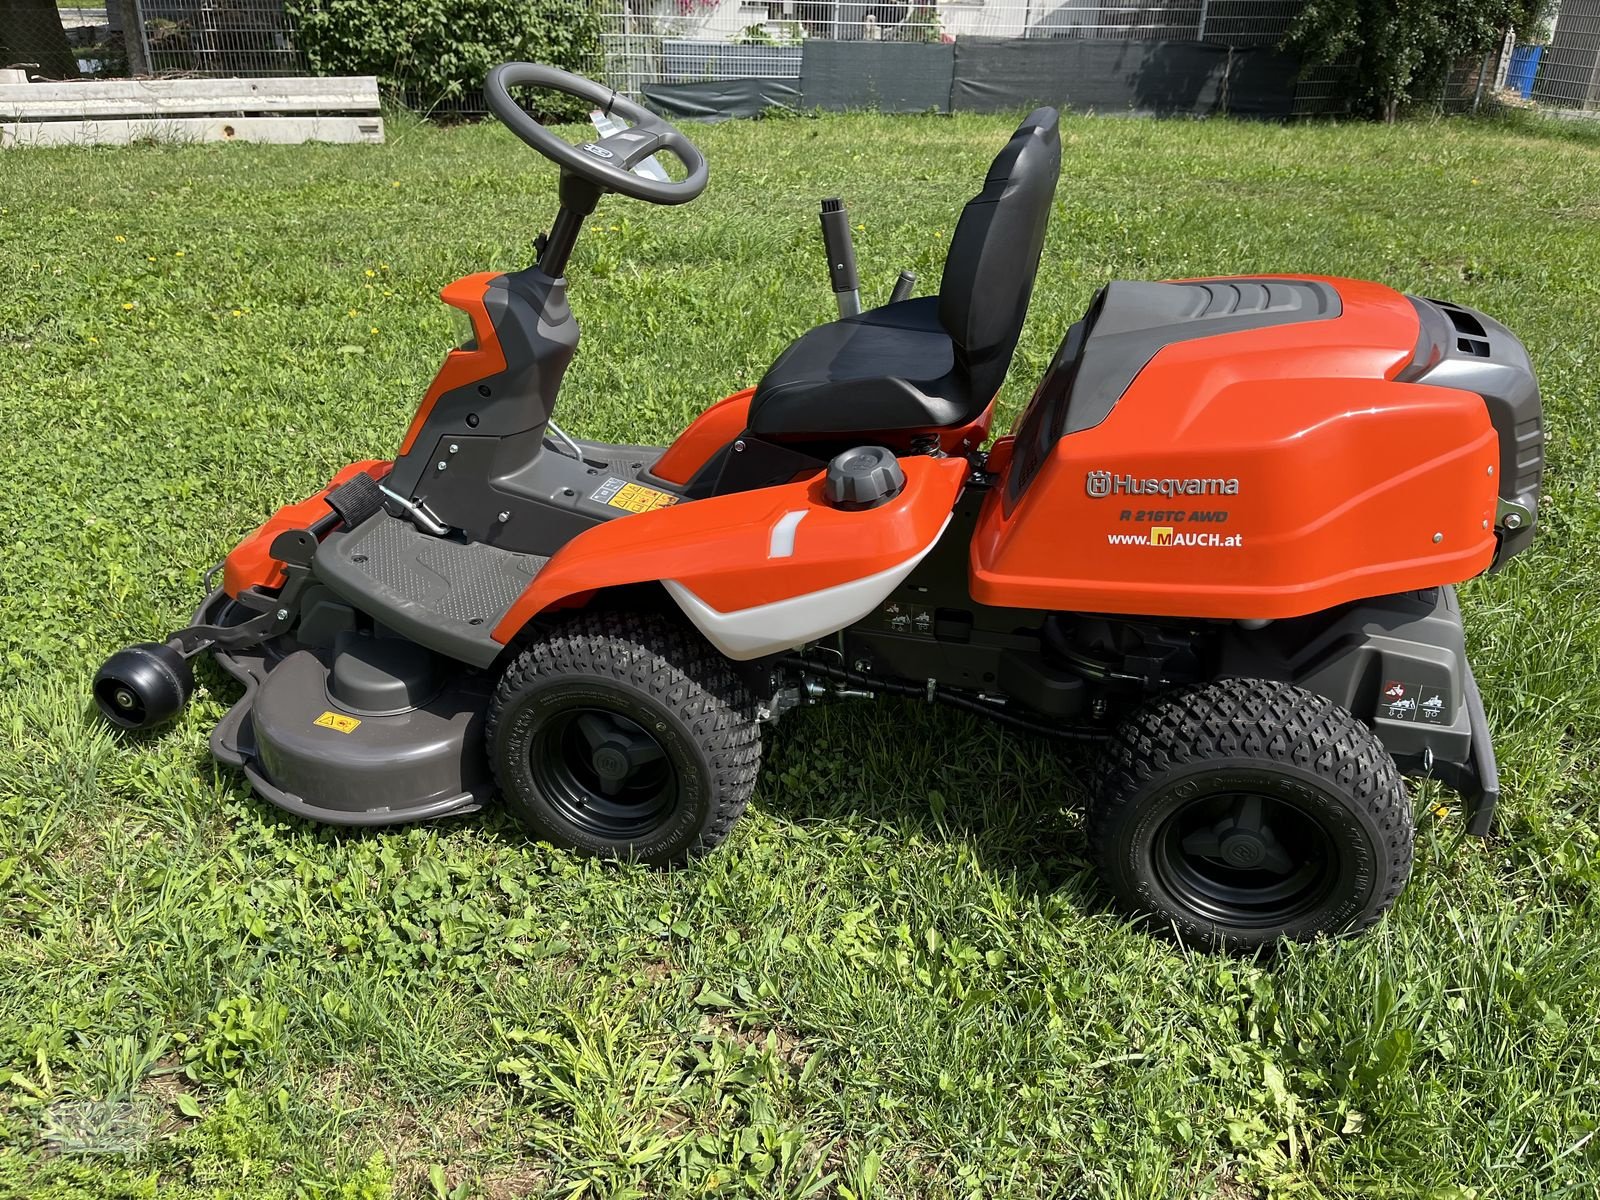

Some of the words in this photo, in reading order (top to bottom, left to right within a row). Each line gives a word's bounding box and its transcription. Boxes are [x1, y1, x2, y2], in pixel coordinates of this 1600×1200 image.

[1113, 474, 1239, 498] Husqvarna
[1119, 510, 1132, 522] R
[1135, 510, 1186, 522] 216TC
[1188, 511, 1228, 523] AWD
[1107, 530, 1243, 547] www.MAUCH.at
